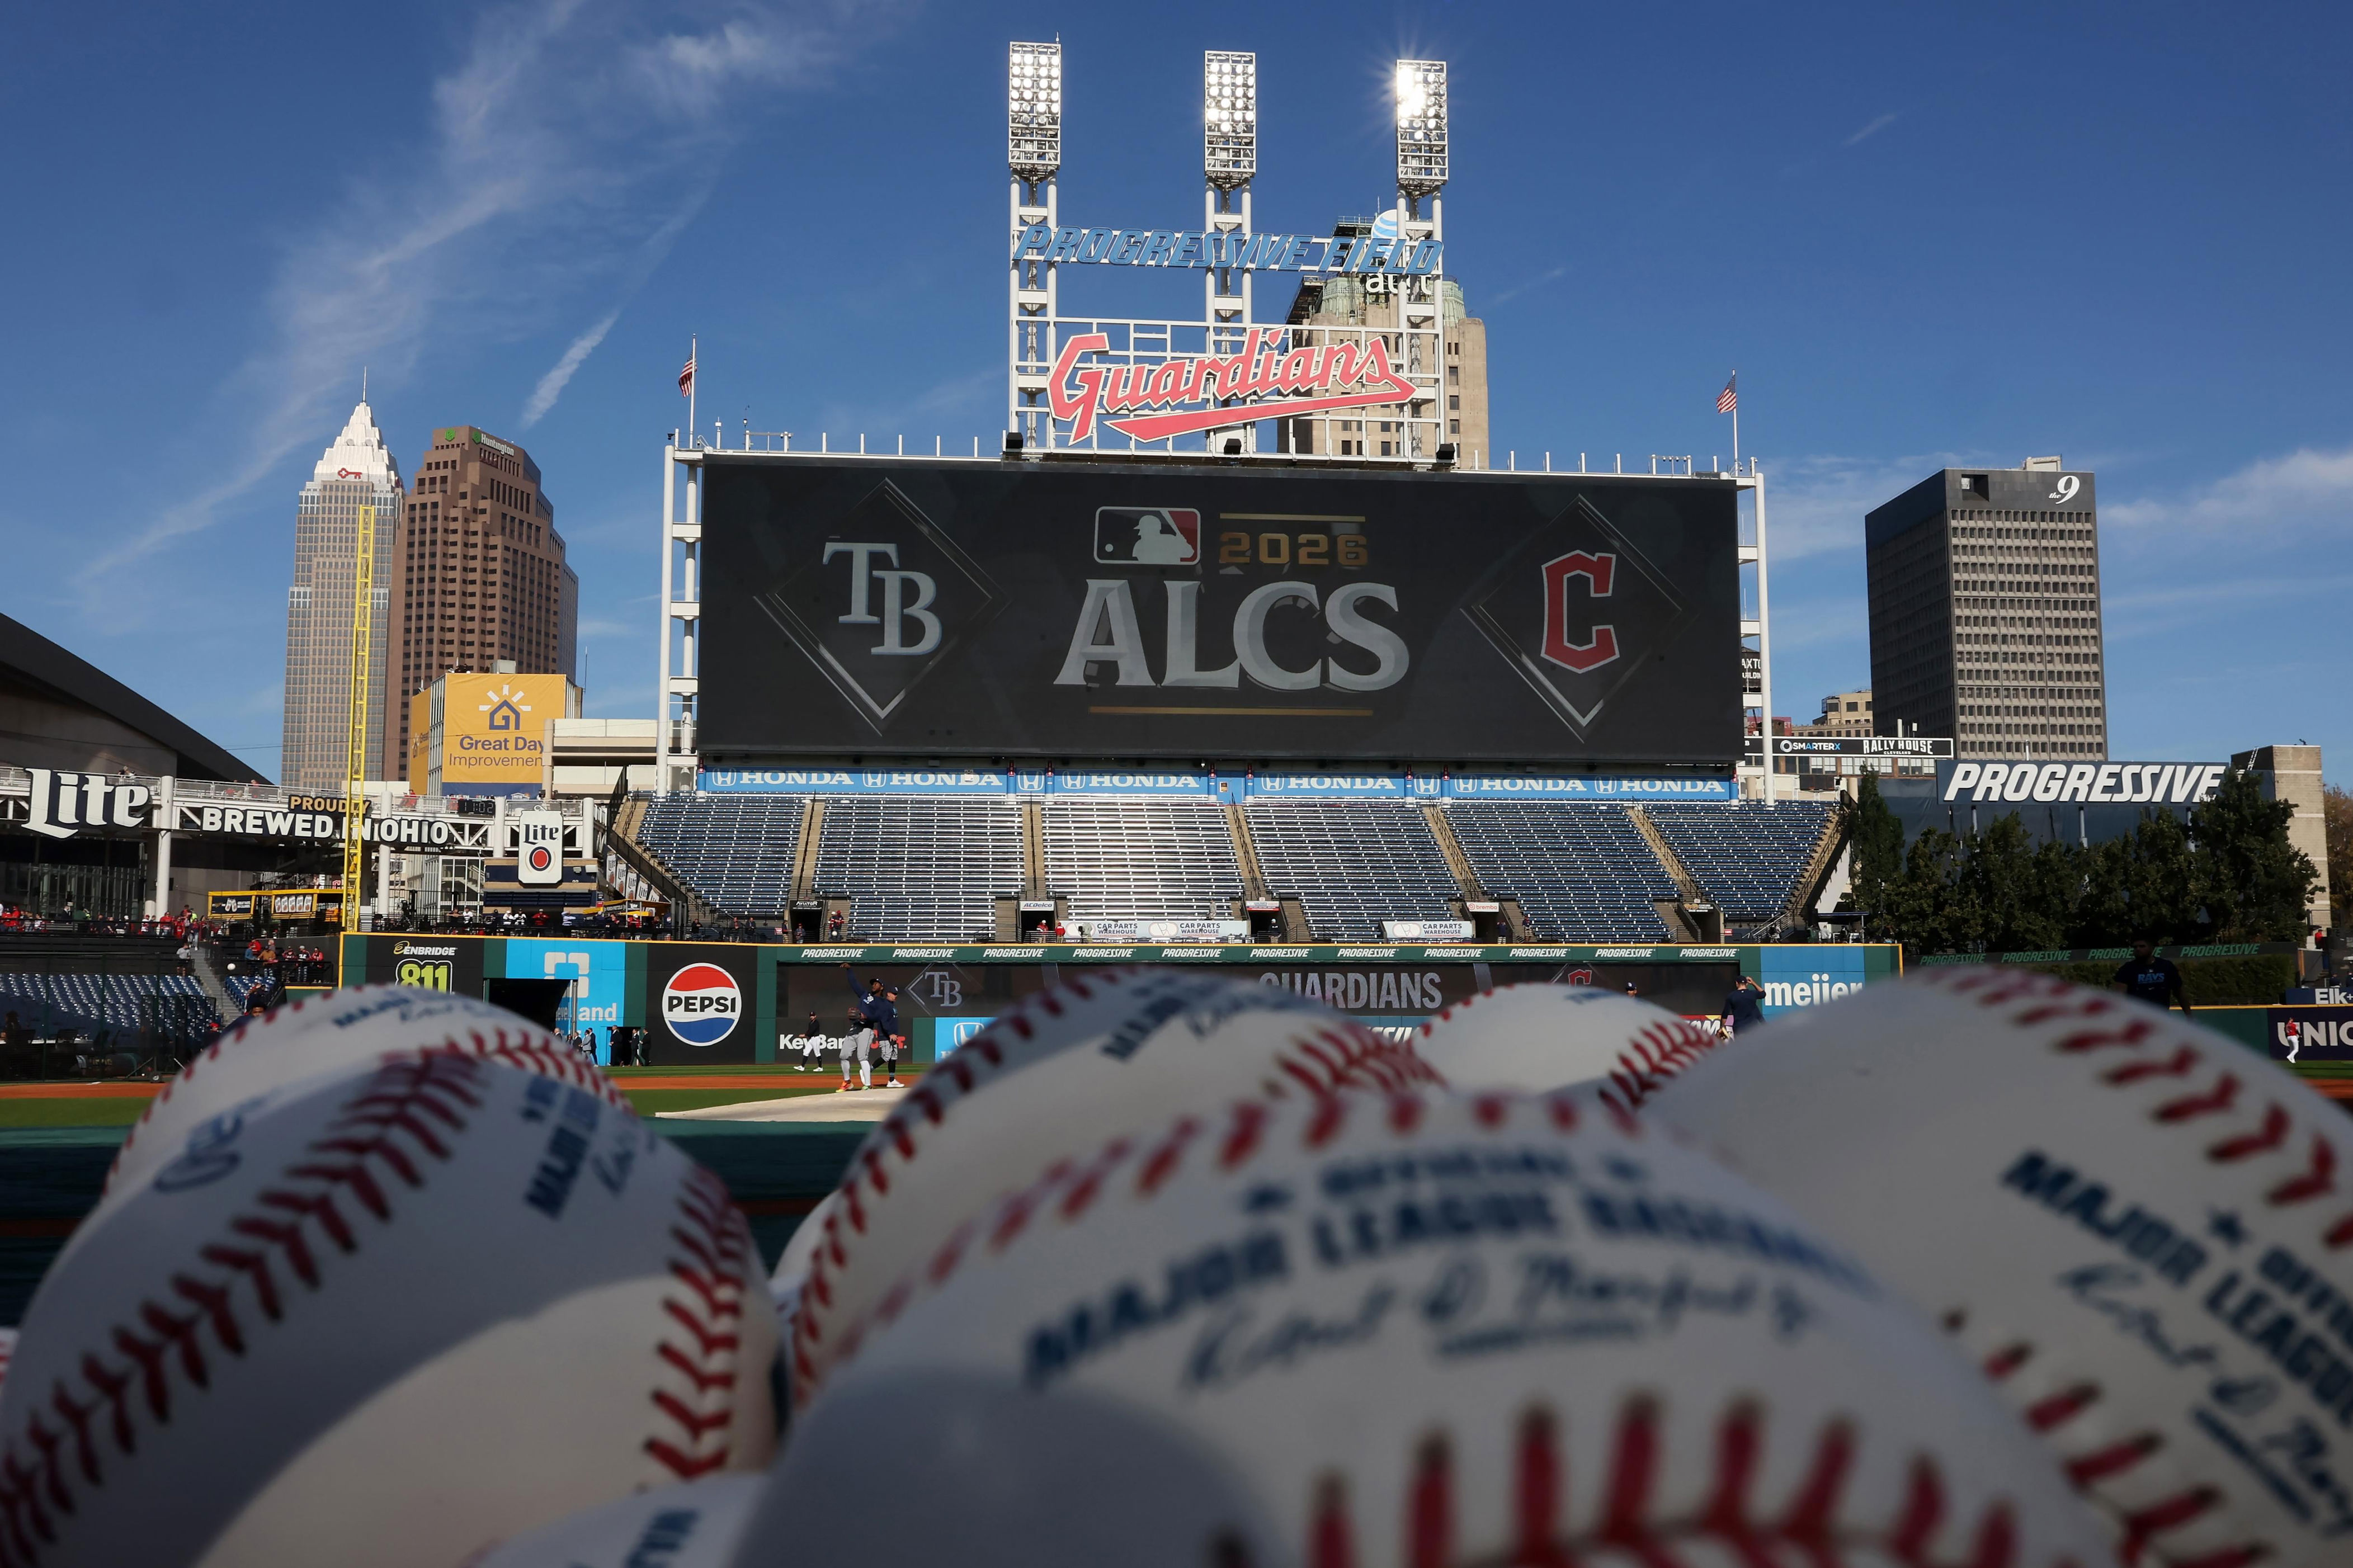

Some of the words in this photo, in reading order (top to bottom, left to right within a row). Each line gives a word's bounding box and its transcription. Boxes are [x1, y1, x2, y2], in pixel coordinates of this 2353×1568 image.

[1012, 224, 1314, 272] PROGRESSIVE
[1317, 237, 1444, 275] FIELD
[1047, 327, 1405, 446] Guardians
[481, 433, 514, 456] Huntington
[2055, 475, 2080, 504] 9
[1219, 532, 1368, 565] 2026
[822, 542, 942, 655] TB
[1054, 580, 1410, 692] ALCS
[460, 736, 510, 750] Great
[515, 736, 544, 754] Day
[1863, 740, 1895, 754] RALLY
[1898, 740, 1934, 755] HOUSE
[735, 770, 854, 785] HONDA
[1089, 773, 1200, 788] HONDA
[1287, 776, 1397, 790] HONDA
[1480, 777, 1587, 791] HONDA
[1619, 778, 1725, 792] HONDA
[1944, 763, 2226, 803] PROGRESSIVE
[21, 768, 149, 839] Lite
[202, 807, 333, 838] BREWED
[380, 818, 449, 844] OHIO
[523, 824, 559, 846] Lite
[403, 946, 455, 956] ENBRIDGE
[801, 948, 863, 958] PROGRESSIVE
[893, 948, 953, 958] PROGRESSIVE
[983, 948, 1044, 958] PROGRESSIVE
[1073, 948, 1133, 958] PROGRESSIVE
[1162, 948, 1222, 958] PROGRESSIVE
[1249, 948, 1309, 958] PROGRESSIVE
[1337, 948, 1396, 958] PROGRESSIVE
[1424, 948, 1482, 958] PROGRESSIVE
[1510, 948, 1567, 958] PROGRESSIVE
[1595, 948, 1653, 958] PROGRESSIVE
[1680, 948, 1737, 958] PROGRESSIVE
[2001, 951, 2071, 963] PROGRESSIVE
[2180, 943, 2261, 957] PROGRESSIVE
[400, 964, 448, 994] 811
[925, 971, 963, 1007] TB
[668, 996, 736, 1013] PEPSI
[2002, 1147, 2208, 1289] MAJOR
[1024, 1229, 1292, 1390] MAJOR
[1309, 1188, 1560, 1268] LEAGUE
